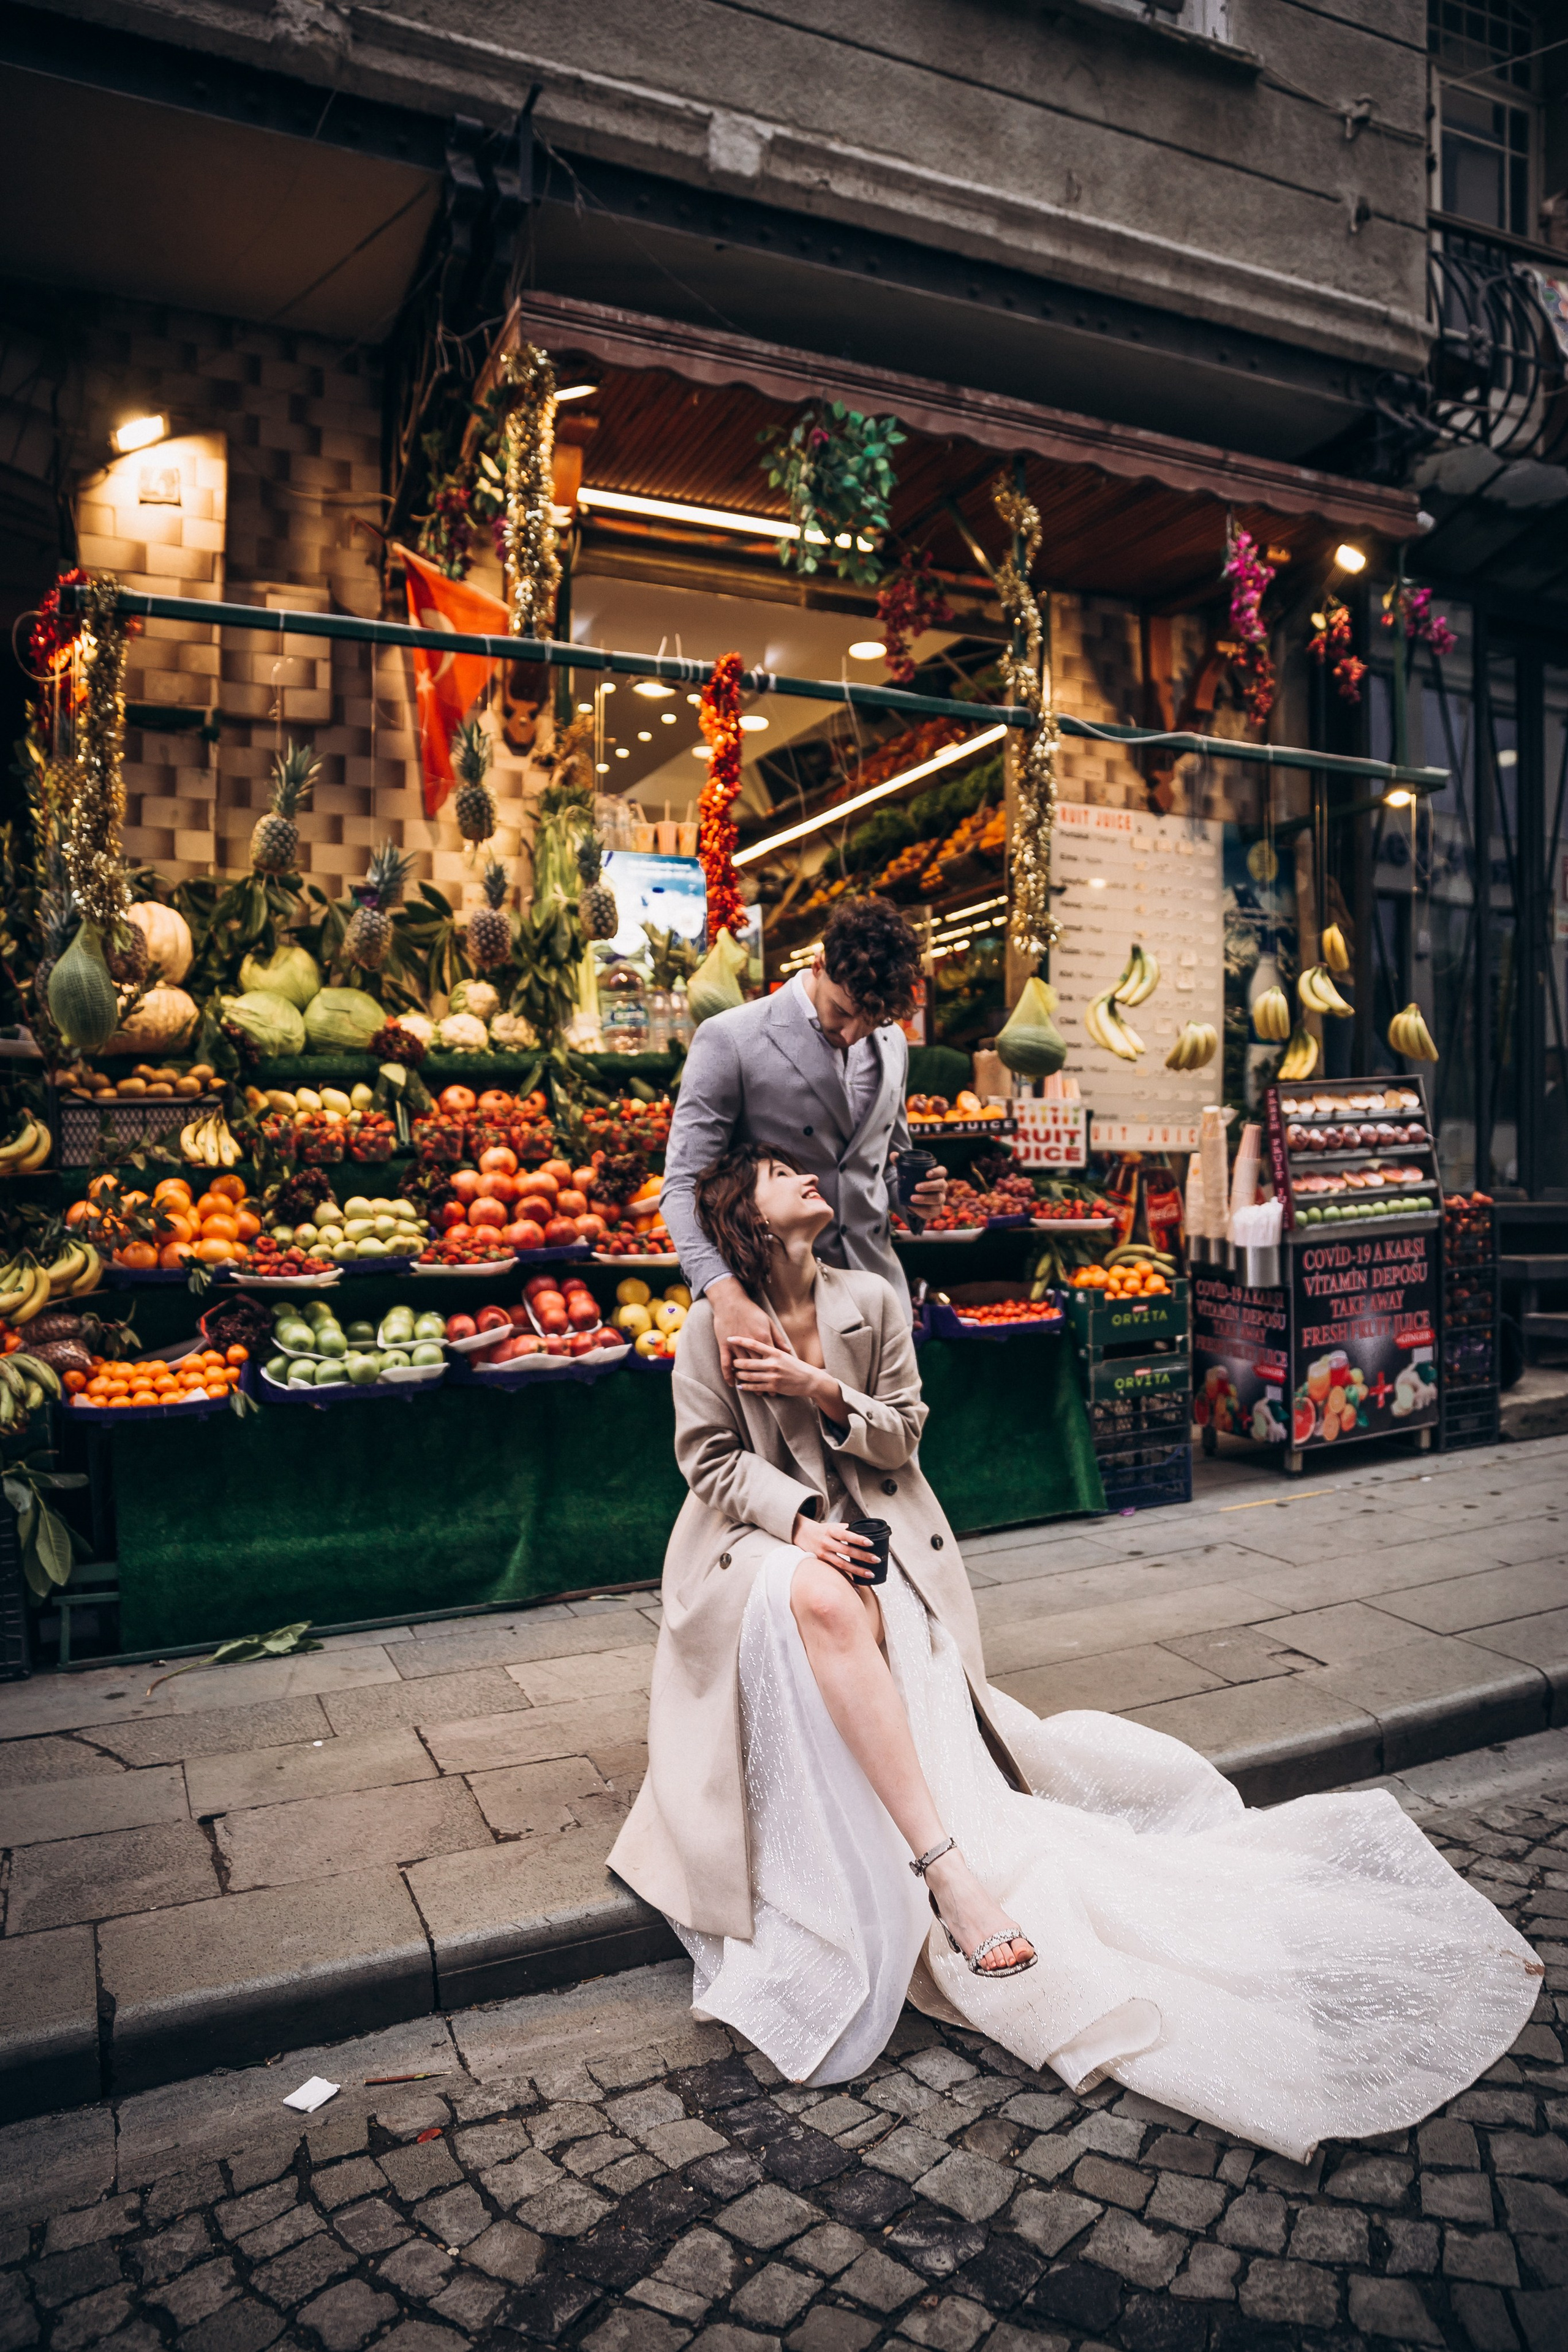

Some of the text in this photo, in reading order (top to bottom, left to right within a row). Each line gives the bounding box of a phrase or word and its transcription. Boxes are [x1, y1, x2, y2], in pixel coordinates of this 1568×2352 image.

[1061, 807, 1089, 824] RUIT
[910, 1120, 1015, 1133] UIT JUICE
[1092, 1126, 1196, 1143] UIT JUIC
[994, 1129, 1081, 1143] RUIT
[1013, 1147, 1080, 1161] UICE
[1272, 1139, 1285, 1180] FRUIT
[1330, 1290, 1406, 1319] TAKE AWAY
[1302, 1310, 1431, 1348] FRESH FRUIT JUICE
